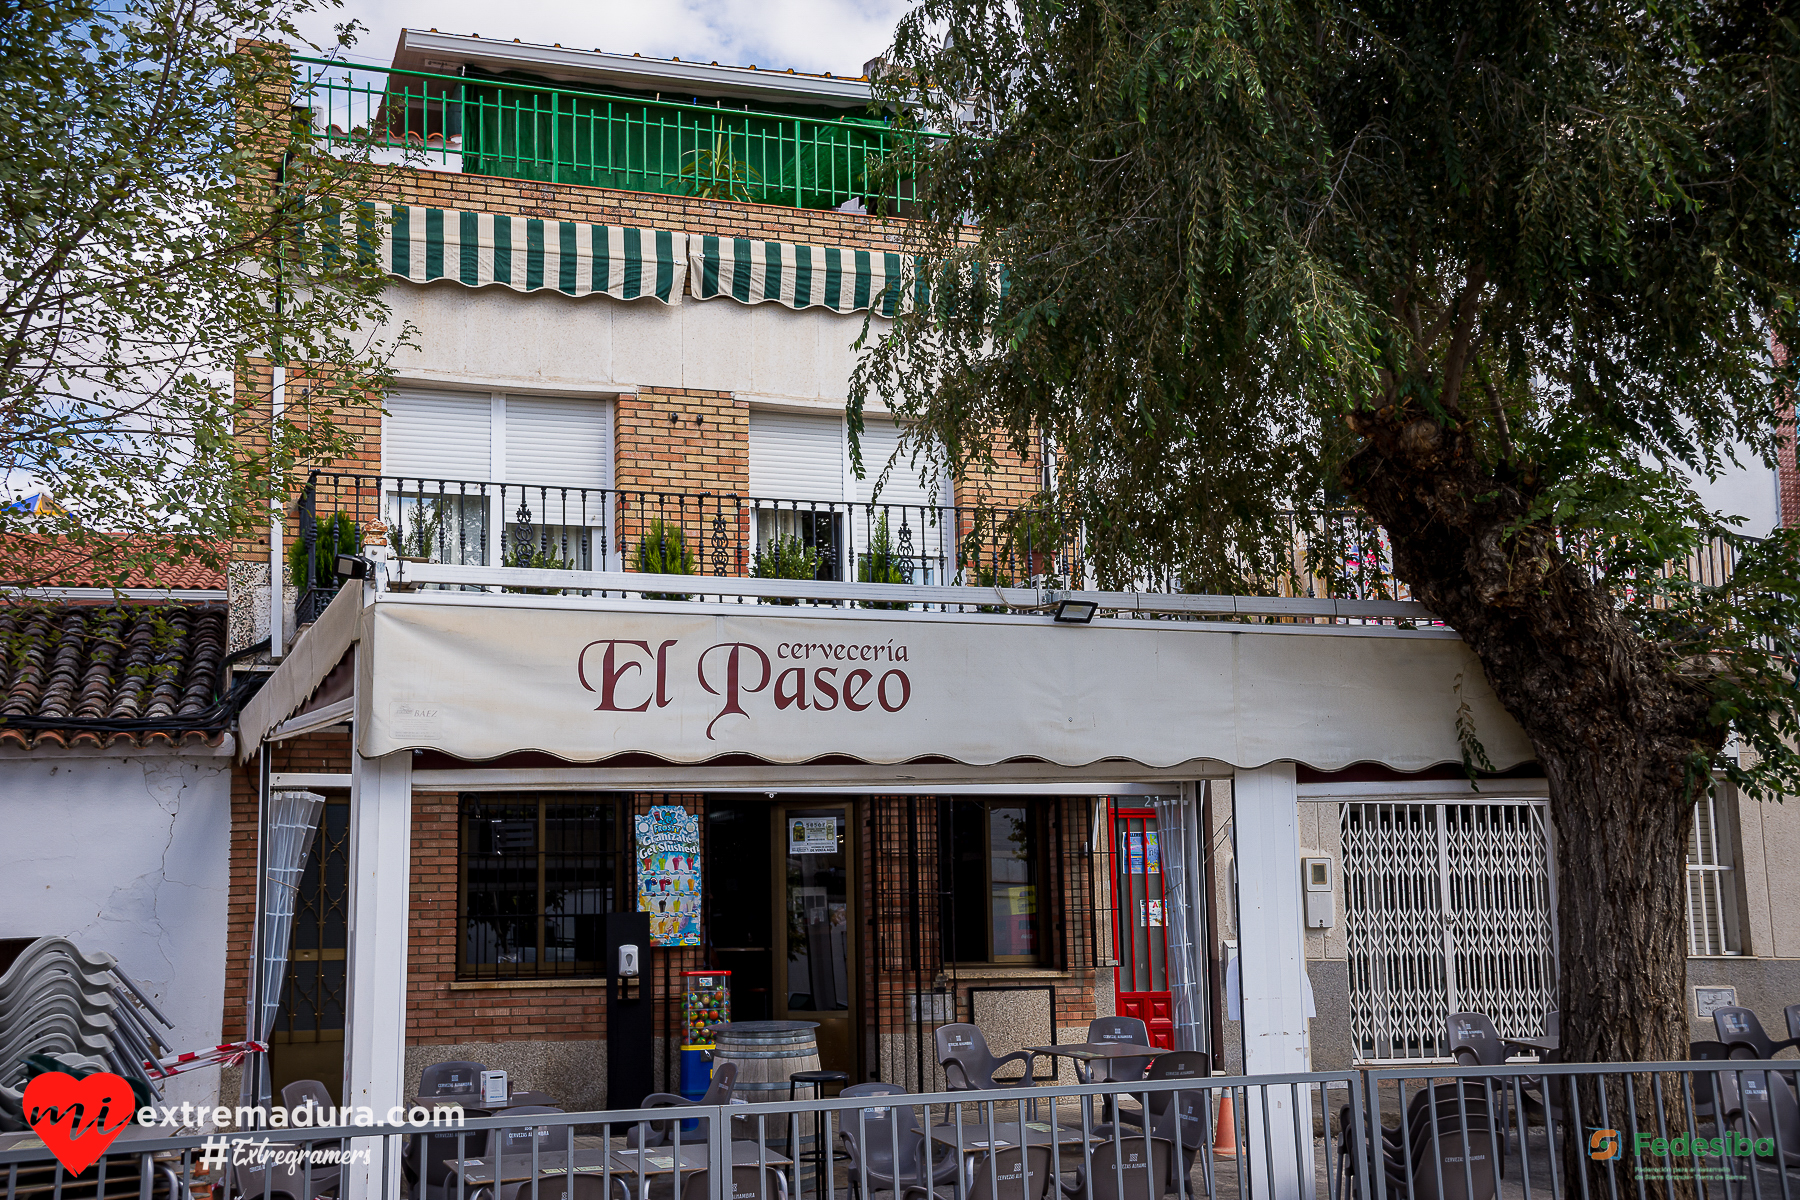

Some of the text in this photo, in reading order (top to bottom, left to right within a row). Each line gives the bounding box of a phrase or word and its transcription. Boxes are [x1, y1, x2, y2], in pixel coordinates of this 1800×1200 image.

[776, 638, 910, 663] cervecería
[577, 638, 913, 741] El Paseo
[653, 823, 681, 834] FROSTY
